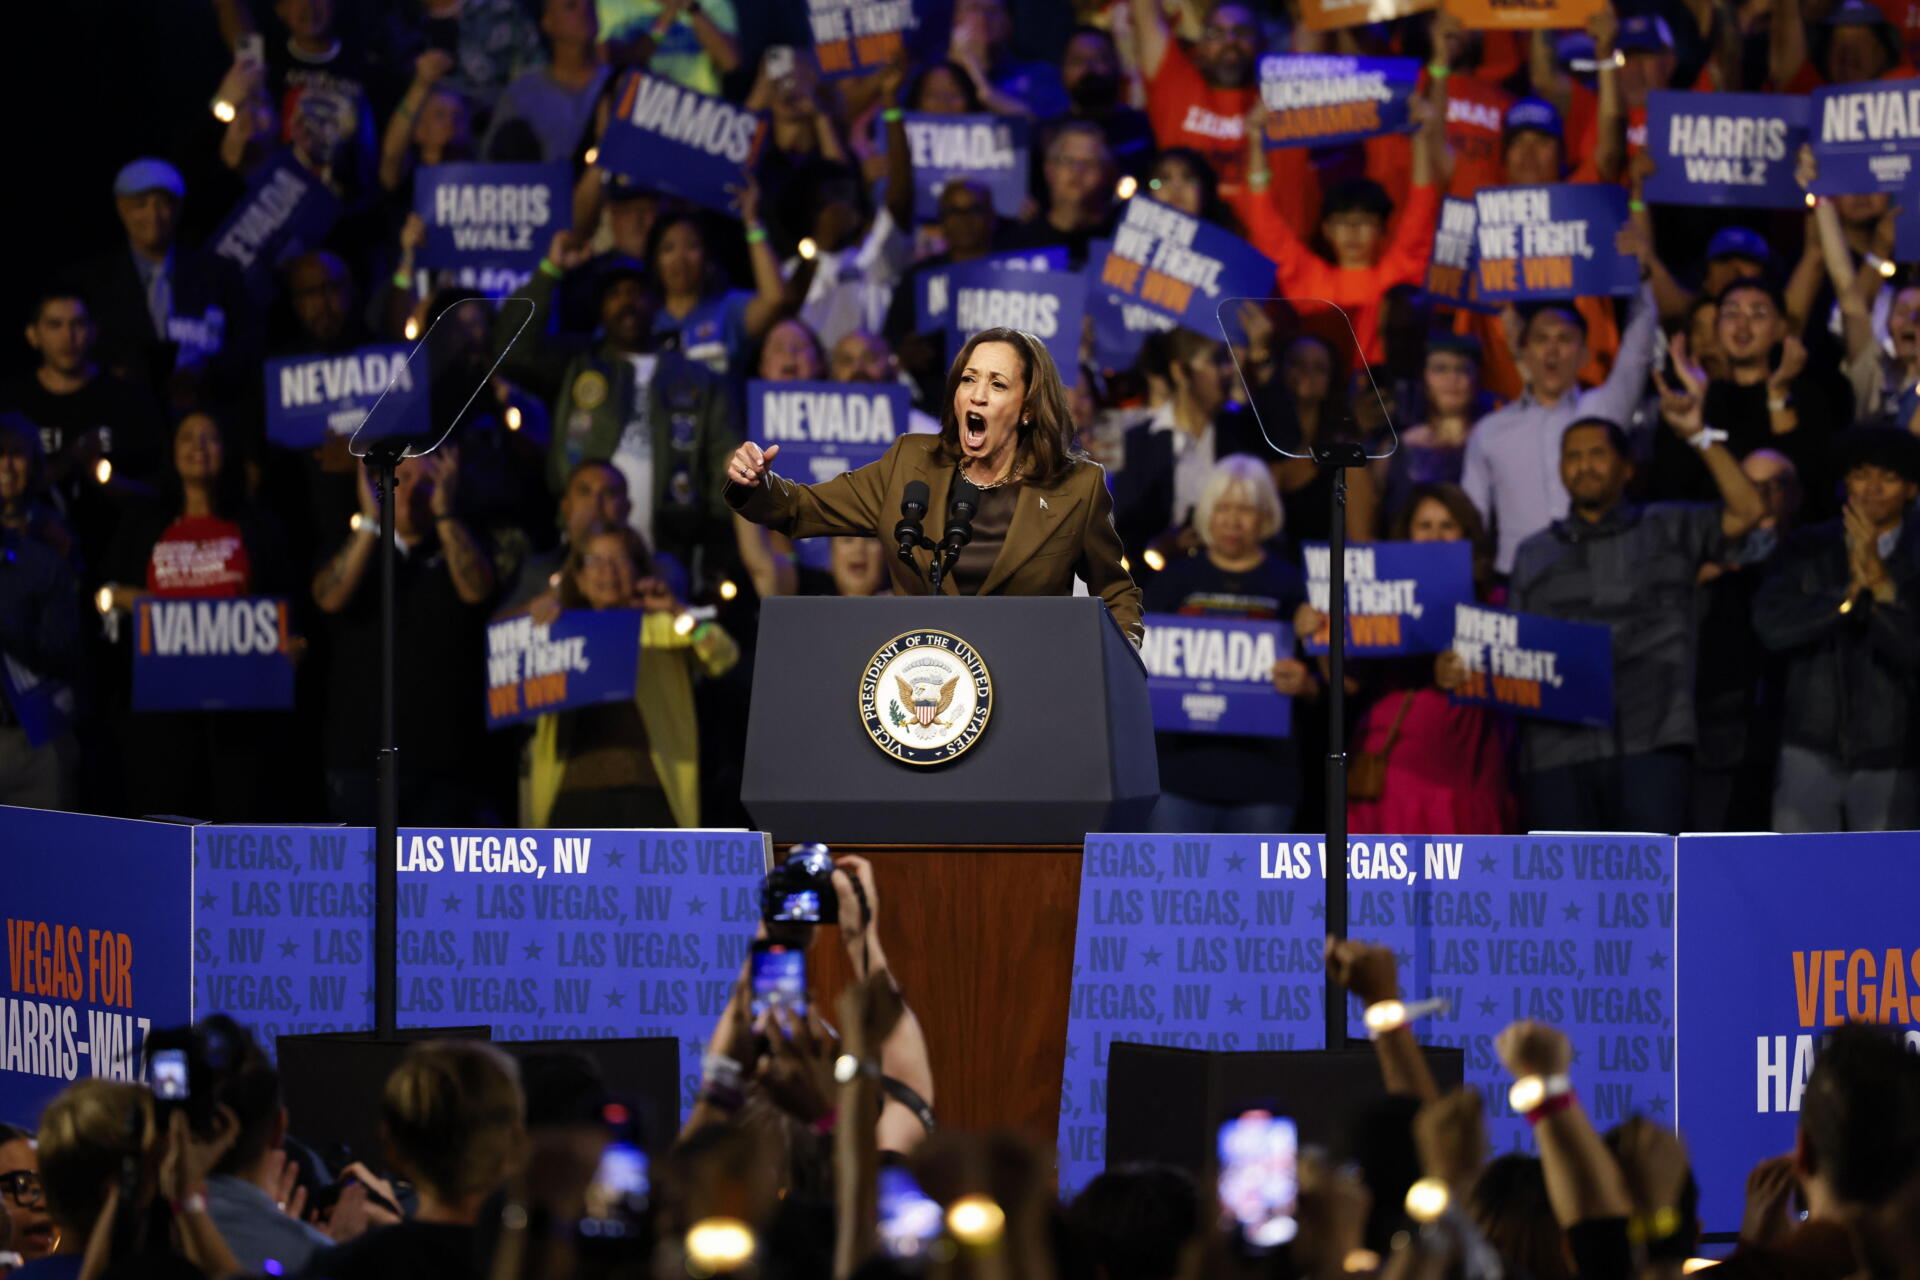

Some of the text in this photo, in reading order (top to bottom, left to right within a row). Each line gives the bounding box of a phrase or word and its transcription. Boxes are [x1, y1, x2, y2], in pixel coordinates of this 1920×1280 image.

[1669, 114, 1787, 161] HARRIS
[1685, 158, 1767, 186] WALZ
[435, 184, 551, 227] HARRIS
[1126, 195, 1199, 247] WHEN
[1476, 188, 1549, 227] WHEN
[453, 226, 534, 250] WALZ
[1113, 223, 1154, 266] WE
[1478, 220, 1594, 260] WE FIGHT,
[1479, 254, 1573, 292] WE WIN
[957, 287, 1060, 338] HARRIS
[281, 352, 413, 408] NEVADA
[763, 391, 896, 443] NEVADA
[1304, 546, 1376, 582] WEN
[1348, 579, 1423, 619] FIGHT,
[1350, 616, 1402, 647] WIN
[1455, 603, 1518, 647] WHEN
[488, 636, 590, 688] WE FIGHT,
[1139, 626, 1276, 682] NEVADA
[1491, 643, 1563, 688] FIGHT,
[863, 635, 989, 756] VICE PRESIDENT OF THE UNITED STATES
[207, 834, 347, 876] VEGAS, NV
[396, 836, 591, 879] LAS VEGAS, NV
[639, 839, 688, 875] LAS
[1173, 843, 1211, 878] NV
[1260, 842, 1311, 879] LAS
[1425, 844, 1463, 879] NV
[1513, 844, 1671, 885] LAS VEGAS,
[231, 881, 281, 917] LAS
[475, 884, 672, 926] LAS VEGAS, NV
[1093, 890, 1294, 931] LAS VEGAS, NV
[1347, 891, 1547, 931] LAS VEGAS, NV
[1599, 892, 1649, 928] LAS
[7, 918, 84, 1001] VEGAS
[89, 929, 133, 1008] FOR
[228, 928, 265, 963] NV
[313, 929, 362, 965] LAS
[473, 931, 510, 966] NV
[558, 932, 606, 968] LAS
[613, 933, 709, 974] VEGAS,
[1090, 936, 1128, 972] NV
[1176, 937, 1228, 973] LAS
[1428, 939, 1632, 981] LAS VEGAS, NV
[207, 975, 346, 1016] VEGAS, NV
[396, 978, 591, 1018] LAS VEGAS, NV
[639, 980, 688, 1015] LAS
[1070, 984, 1211, 1024] VEGAS, NV
[1261, 985, 1311, 1021] LAS
[1513, 987, 1671, 1029] LAS VEGAS,
[1599, 1036, 1649, 1072] LAS
[1595, 1084, 1632, 1119] NV
